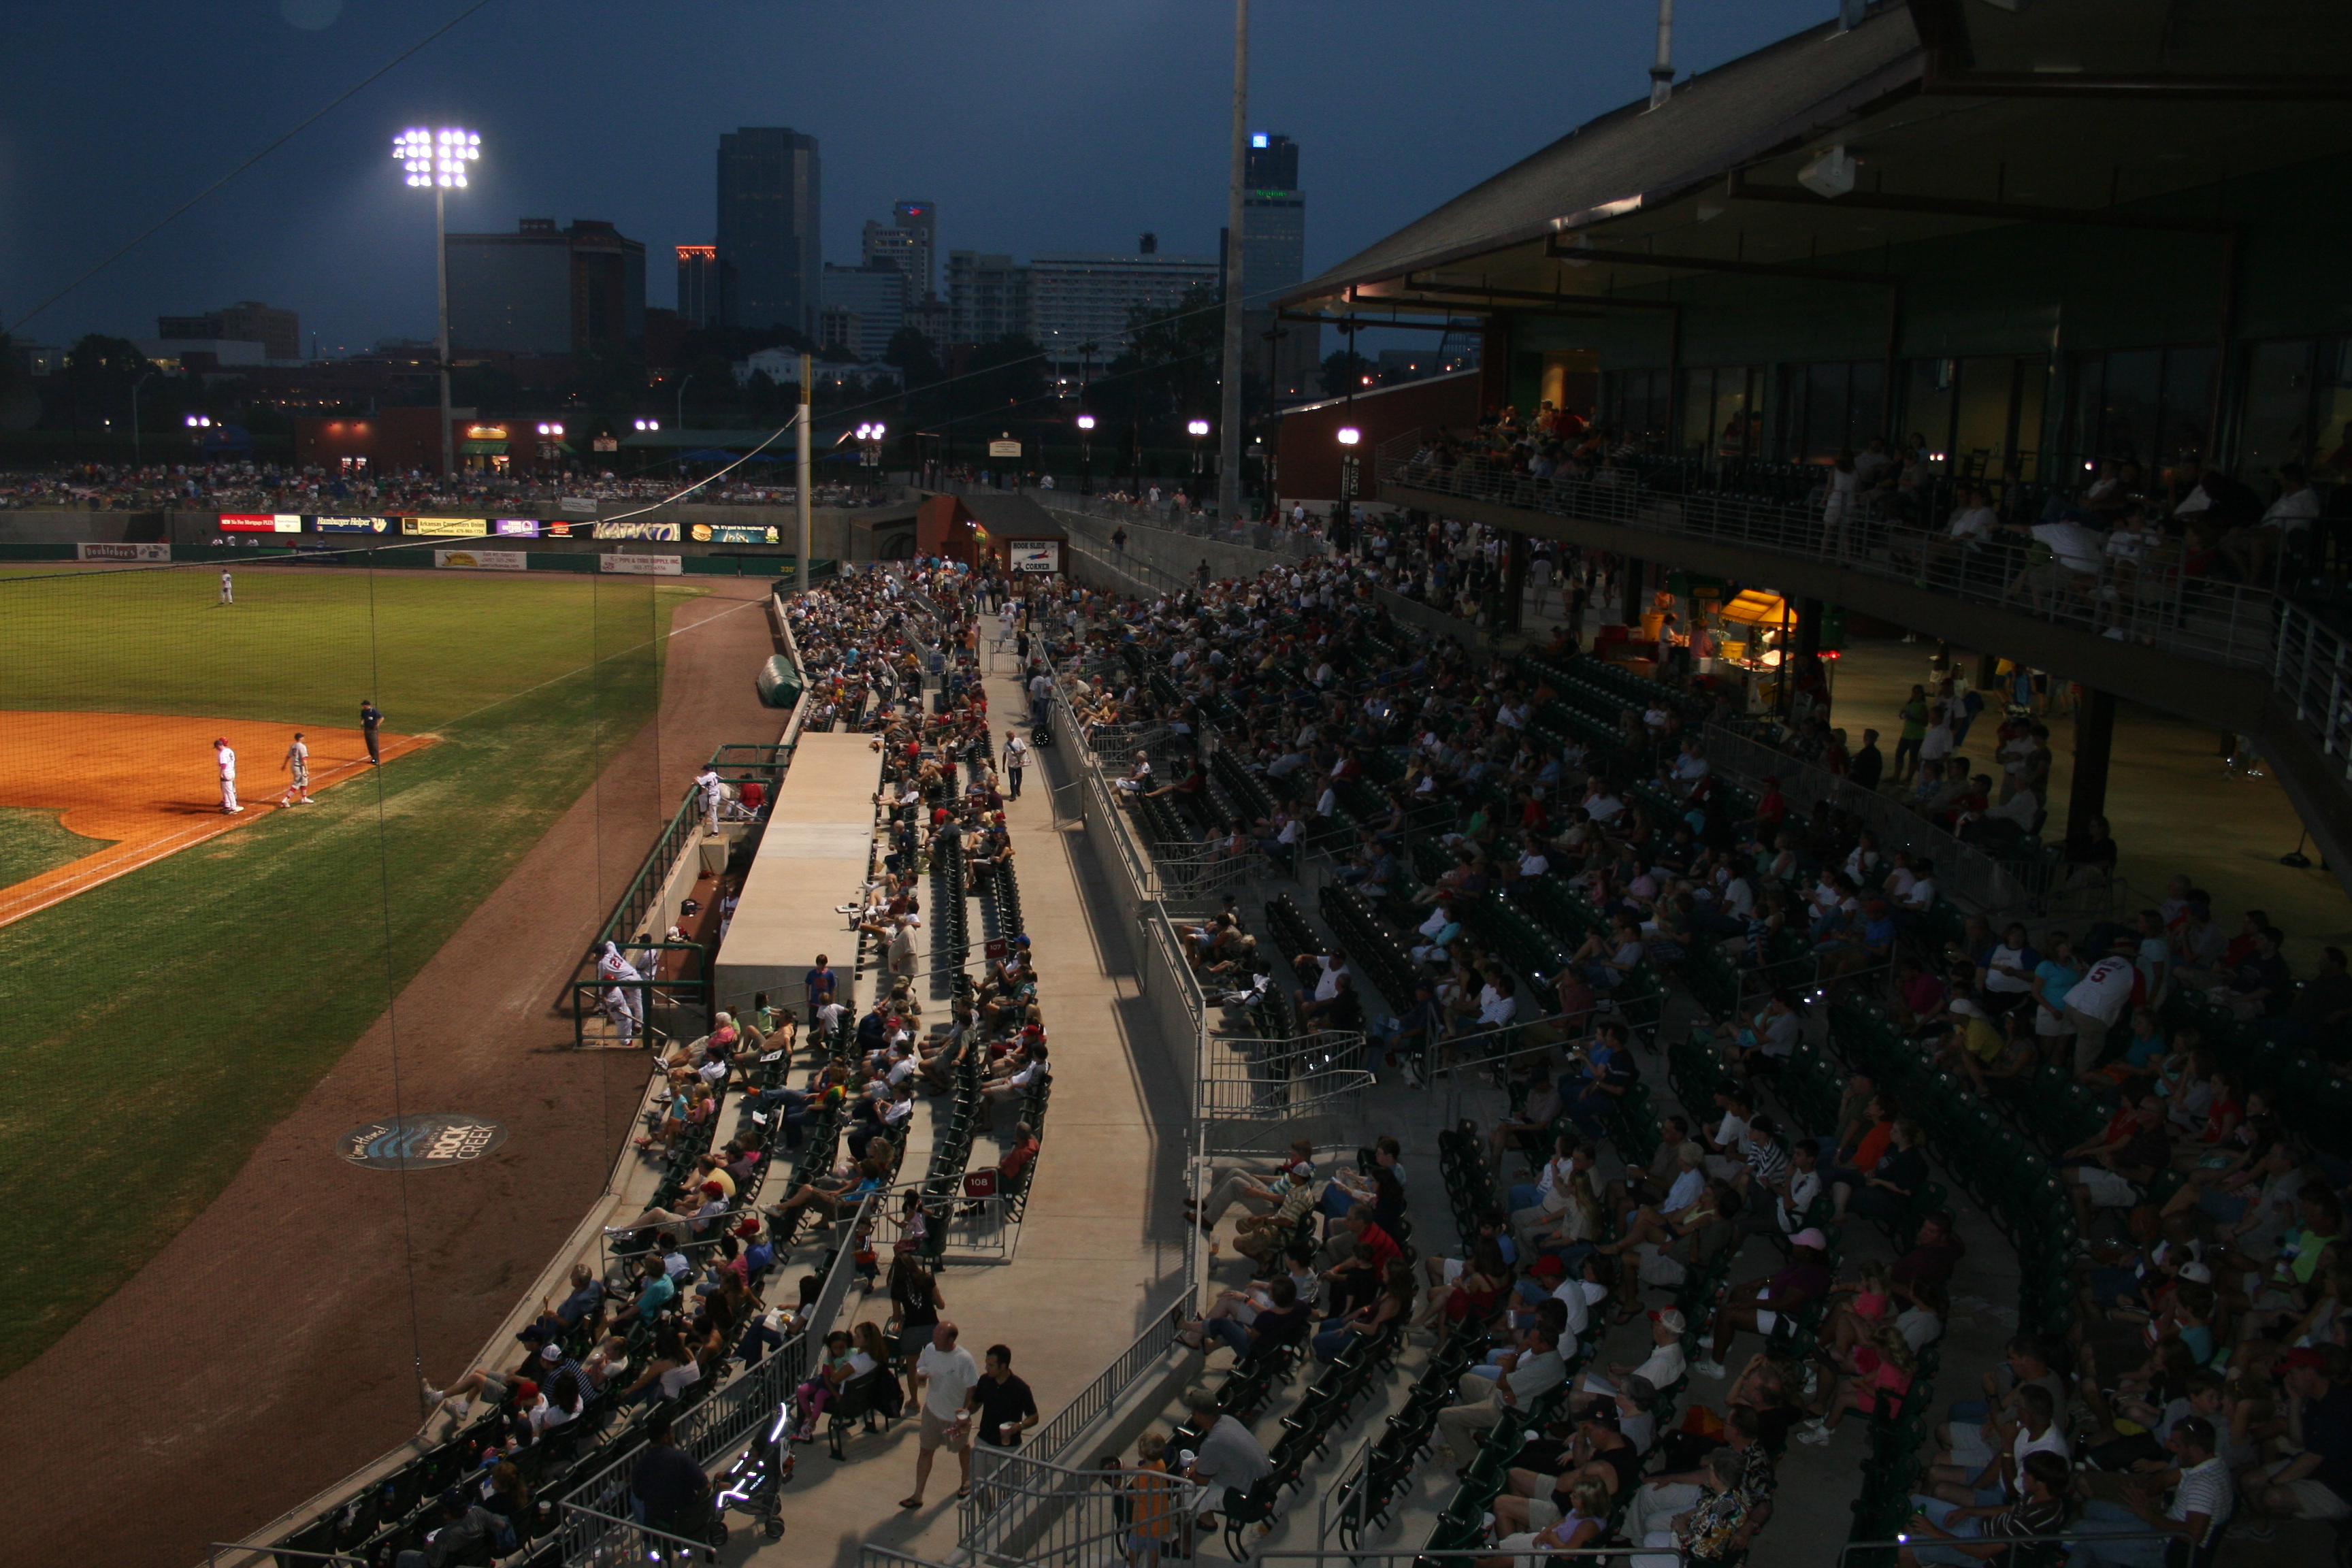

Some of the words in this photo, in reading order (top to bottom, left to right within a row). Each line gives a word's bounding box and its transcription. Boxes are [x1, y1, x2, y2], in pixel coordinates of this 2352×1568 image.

[1256, 190, 1288, 198] Regions
[317, 517, 350, 527] Hamburger
[350, 517, 370, 527] Helper
[86, 544, 135, 556] Doublebee's
[610, 953, 623, 969] 21
[2091, 967, 2112, 982] 5
[427, 1125, 474, 1159] ROCK
[456, 1125, 497, 1160] CREEK
[971, 1178, 987, 1186] 108
